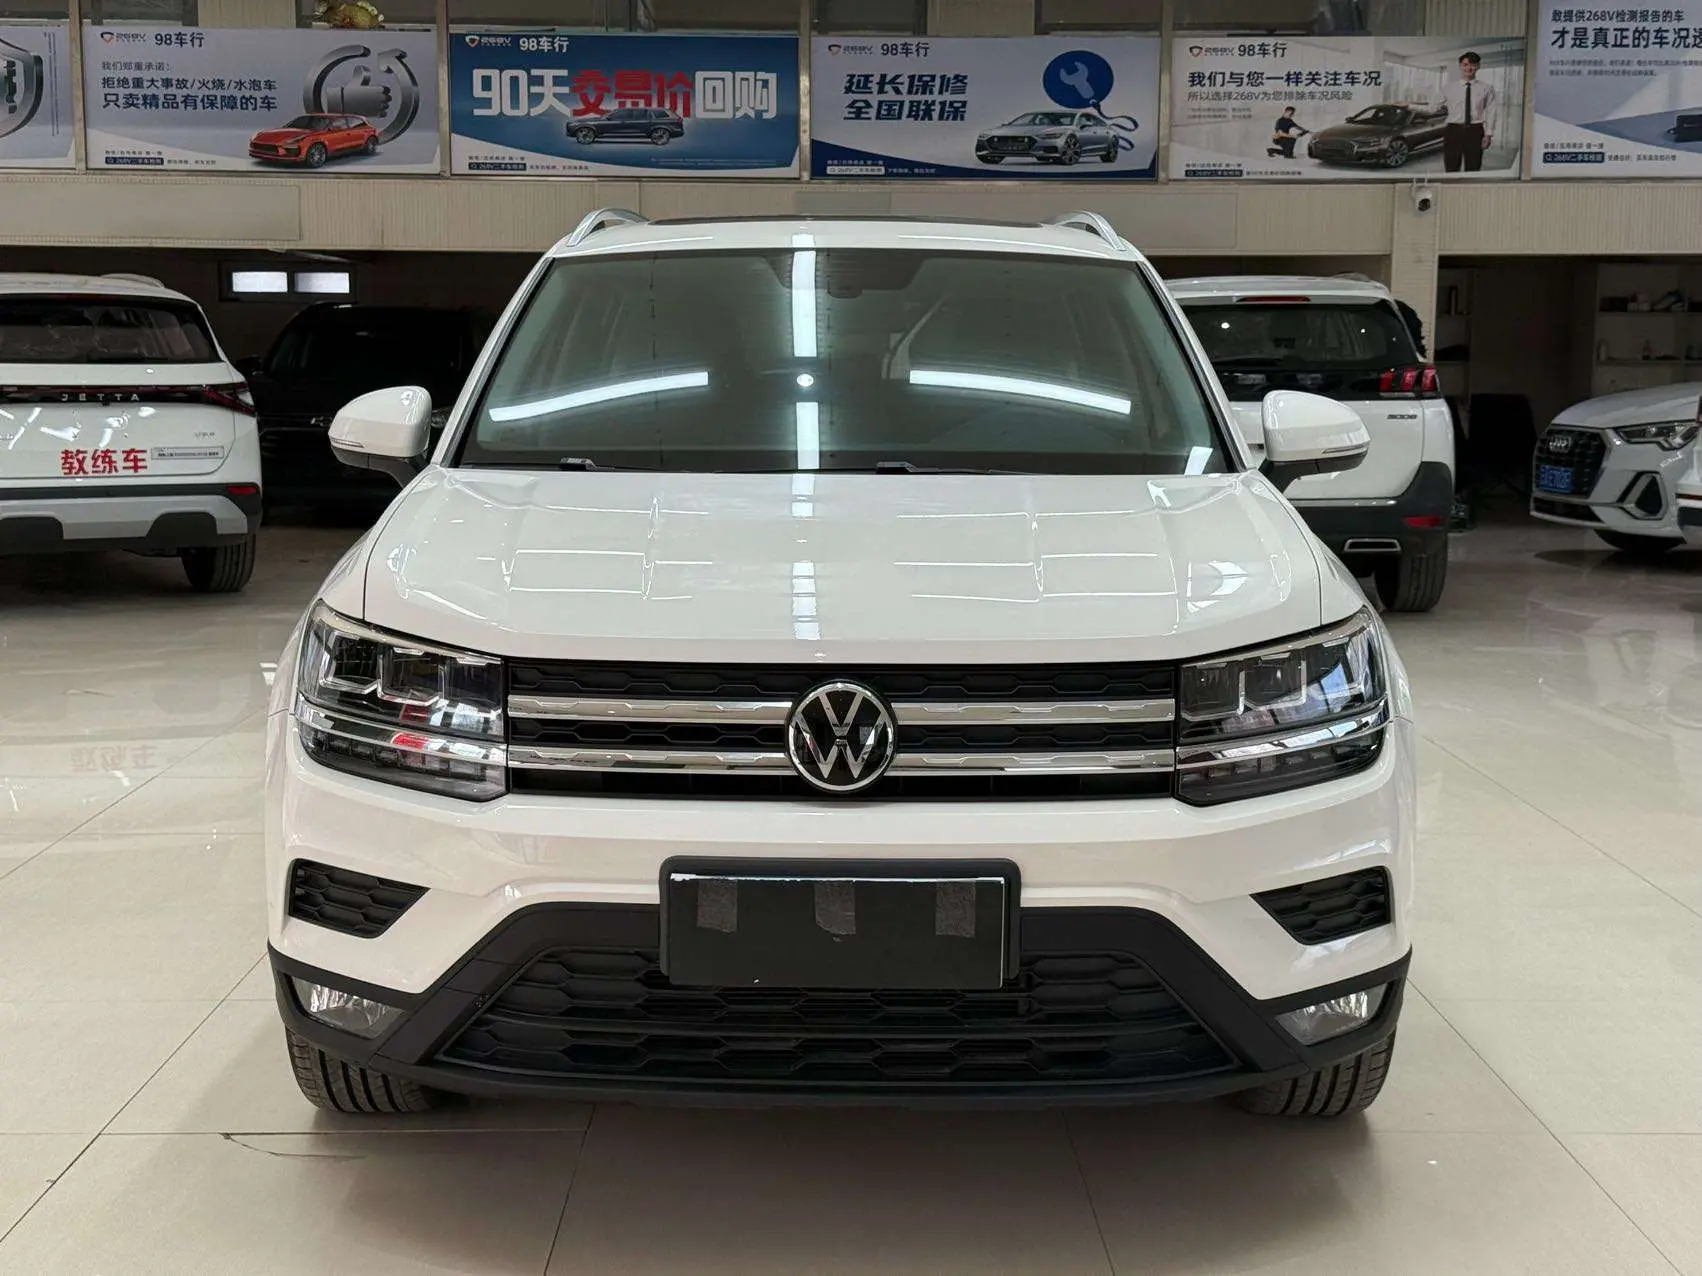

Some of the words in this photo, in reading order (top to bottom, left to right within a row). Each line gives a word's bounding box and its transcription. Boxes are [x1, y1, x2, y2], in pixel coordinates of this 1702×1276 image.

[1552, 9, 1685, 23] 敢提供268V检测报告的车
[154, 32, 205, 48] 98车行
[519, 37, 569, 52] 98车行
[880, 42, 930, 57] 98车行
[1238, 42, 1288, 58] 98车行
[843, 73, 969, 96] 延长保修
[1187, 70, 1382, 88] 我们与您一样关注车况
[102, 93, 278, 111] 只卖精品有保障的车
[472, 69, 778, 119] 90天交易价回购
[843, 99, 968, 122] 全国联保
[61, 393, 140, 402] JETTA
[61, 448, 148, 475] 教练车
